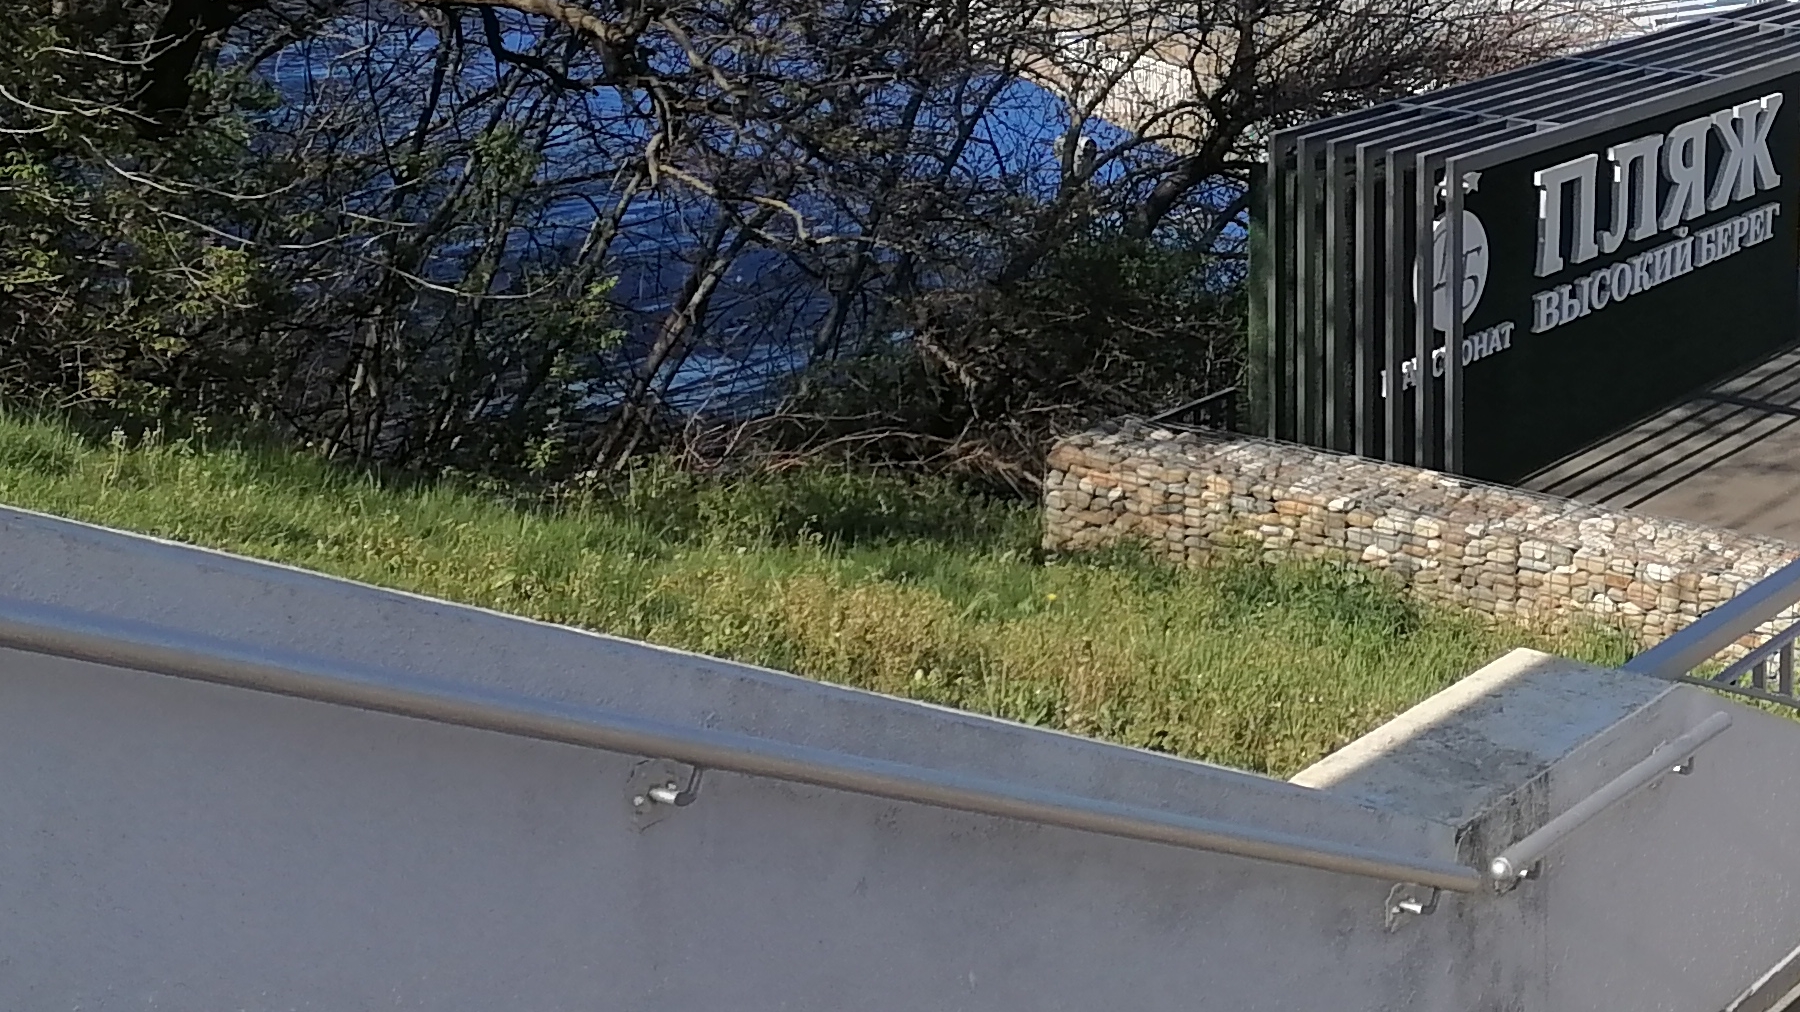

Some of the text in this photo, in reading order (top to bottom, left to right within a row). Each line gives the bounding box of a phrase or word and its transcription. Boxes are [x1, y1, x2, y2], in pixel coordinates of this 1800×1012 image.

[1534, 92, 1783, 277] ПЛЯЖ
[1531, 226, 1695, 333] ВЫСОКИЙ
[1694, 202, 1780, 268] БЕРЕГ
[1381, 321, 1515, 398] АСОНАТ
